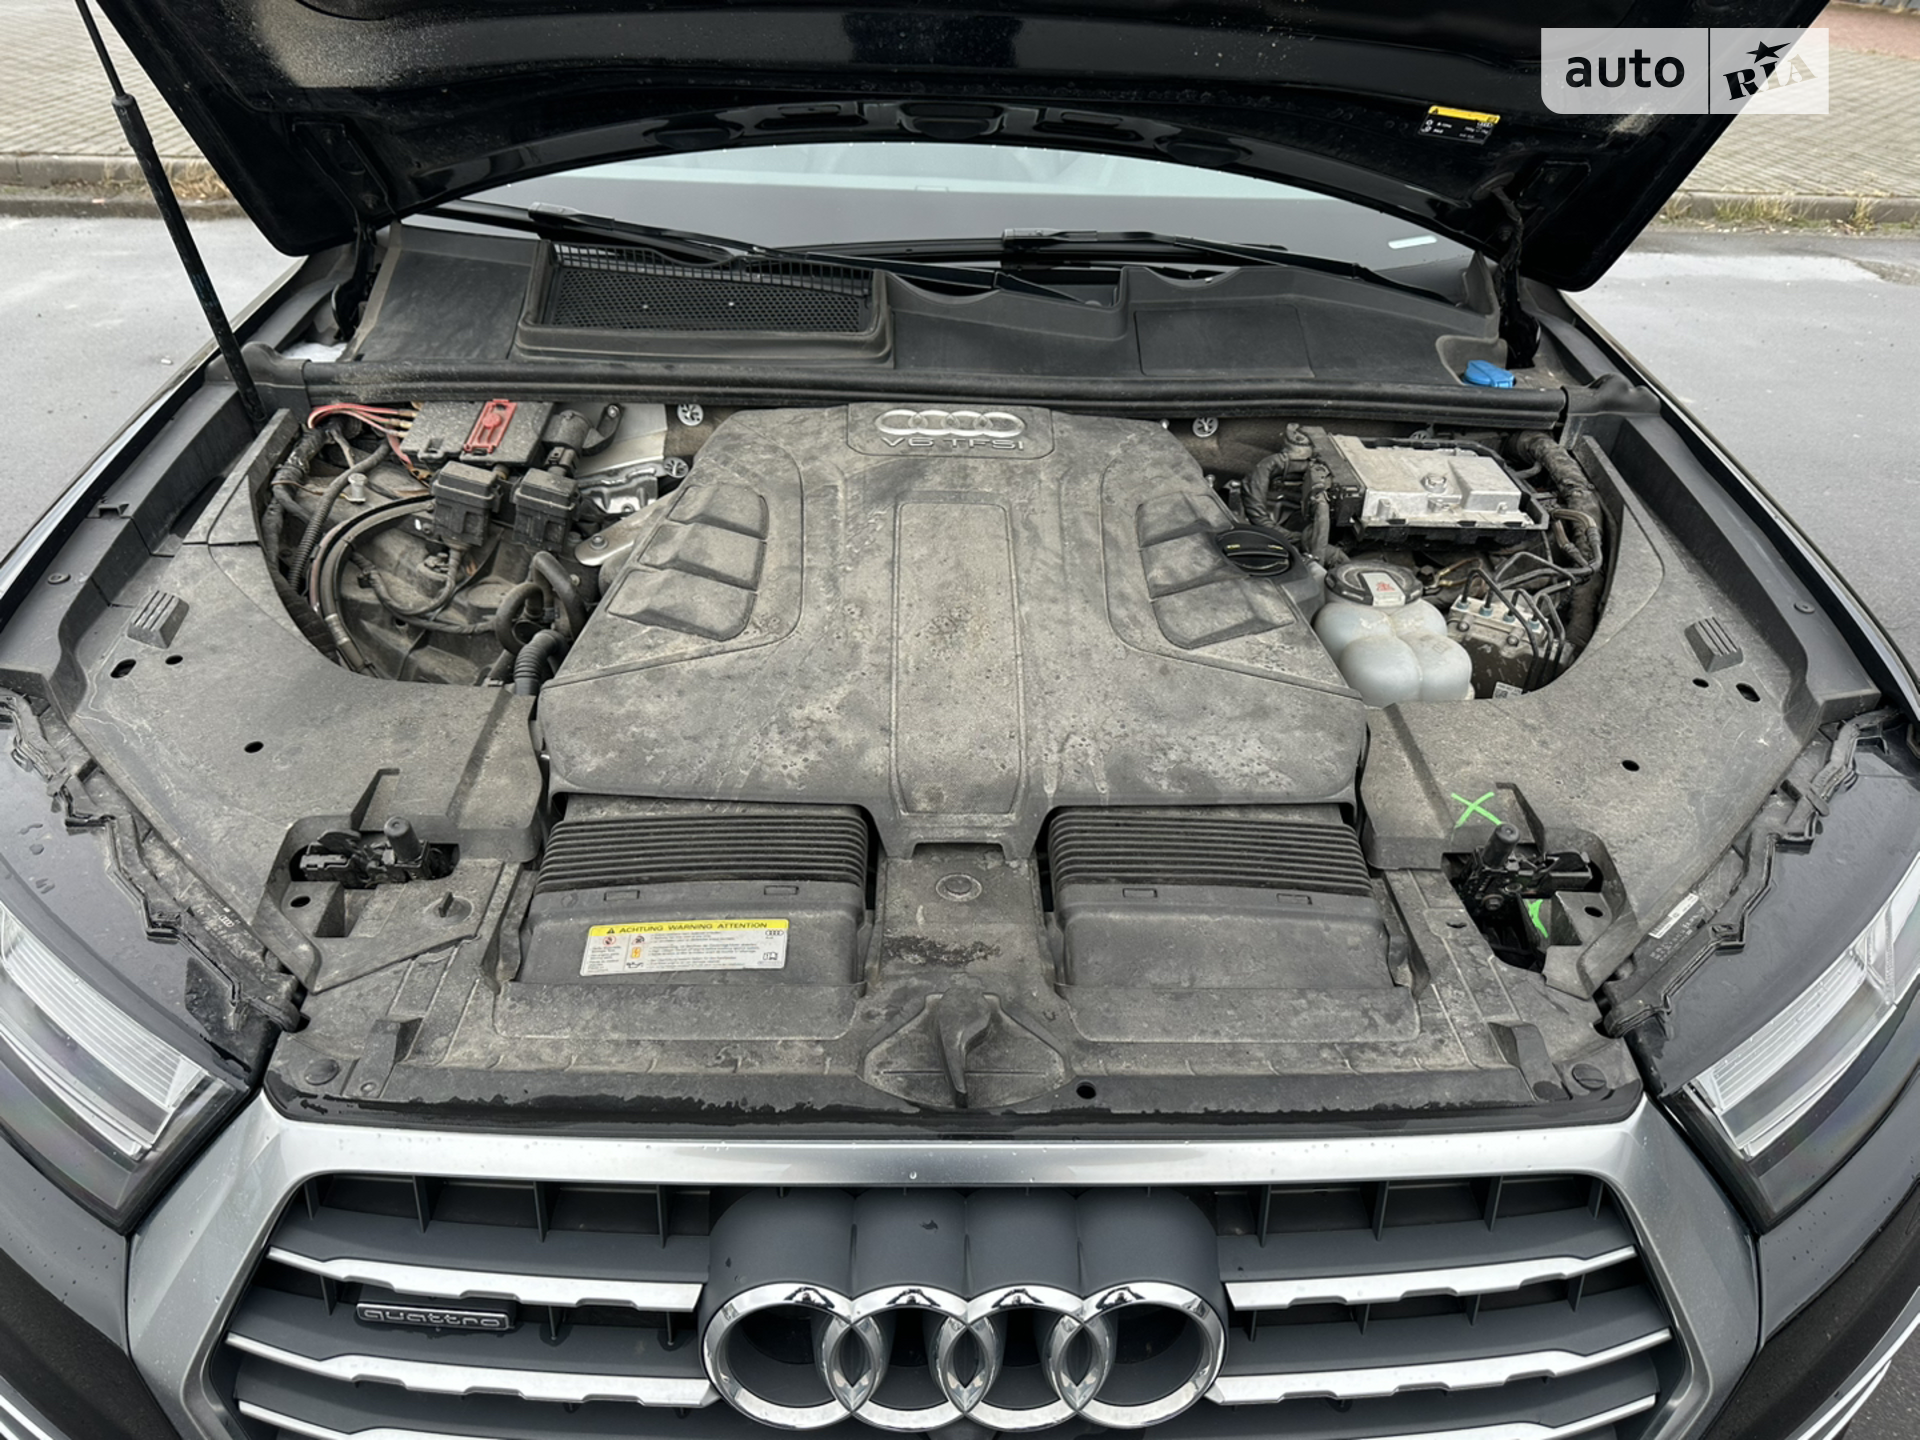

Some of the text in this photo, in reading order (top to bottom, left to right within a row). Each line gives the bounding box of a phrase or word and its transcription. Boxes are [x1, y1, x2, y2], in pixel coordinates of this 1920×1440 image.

[881, 436, 1025, 452] V6 TFSI
[619, 921, 768, 934] ACHTUNG WARNING ATTENTION
[363, 1308, 501, 1328] quattro
